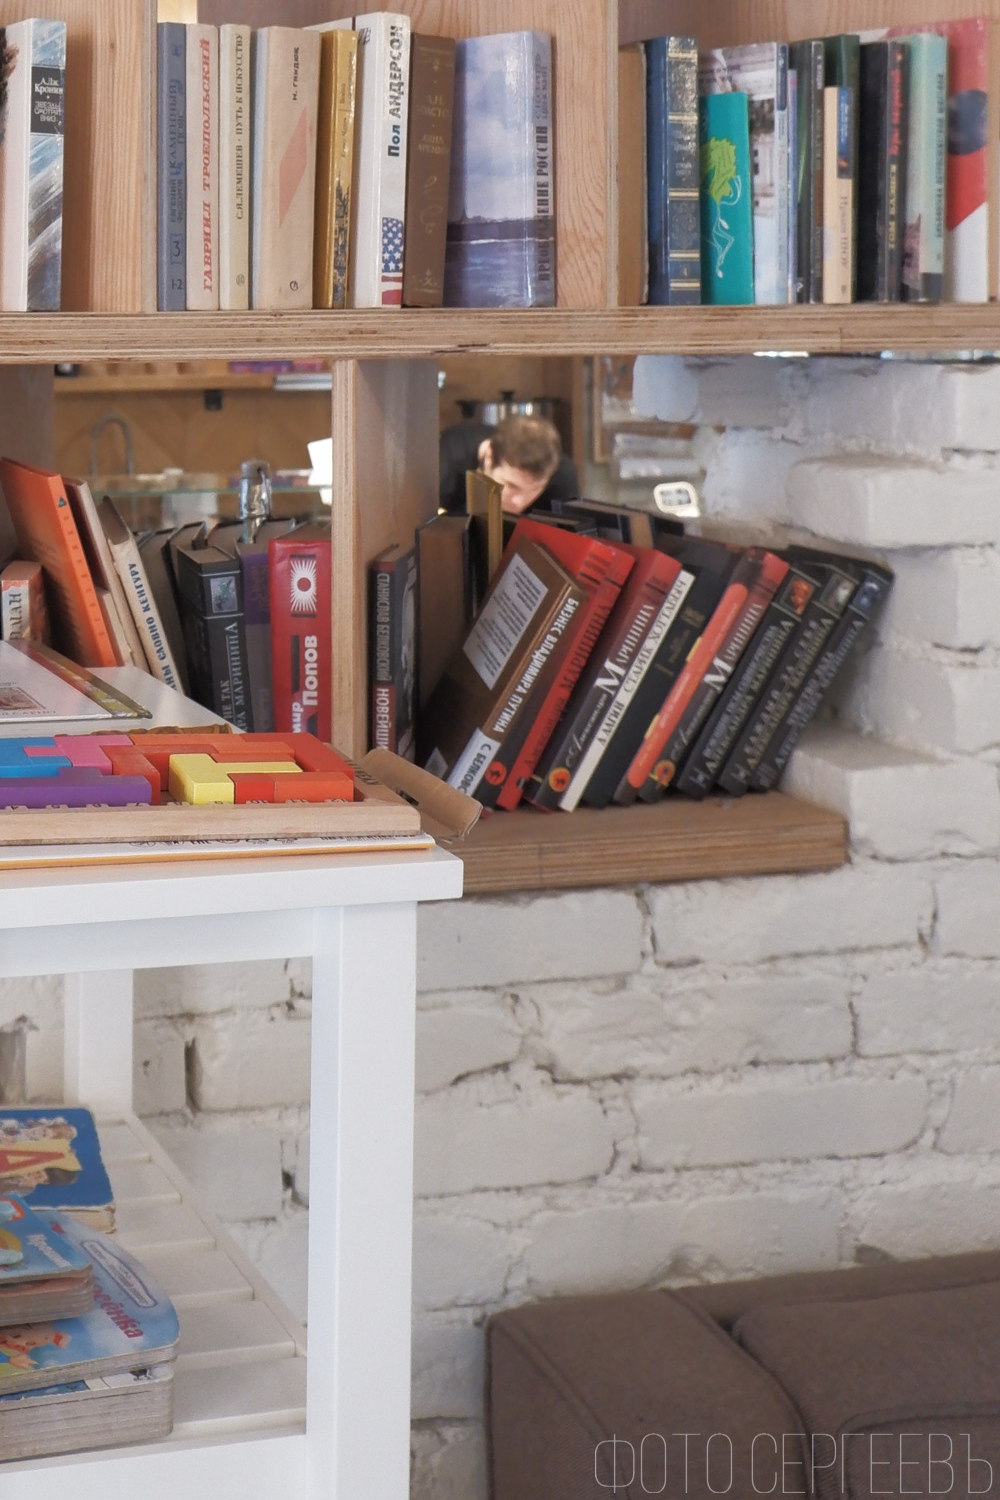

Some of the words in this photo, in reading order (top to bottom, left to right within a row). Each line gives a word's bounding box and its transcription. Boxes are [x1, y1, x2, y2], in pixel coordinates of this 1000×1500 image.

[34, 84, 63, 94] Кронин
[234, 32, 243, 93] ИСКУССТВУ
[387, 24, 404, 118] АНДЕРСОН
[199, 37, 211, 191] ТРОЕПОЛЬСКИЙ
[235, 95, 242, 103] К
[235, 106, 243, 134] ПУТЬ
[386, 123, 401, 157] Пол
[535, 125, 548, 176] РОССИИ
[172, 240, 180, 256] 3
[201, 199, 213, 292] ГАВРИИЛ
[535, 180, 549, 281] ПРЕОБРАЖЕНИЕ
[124, 561, 154, 613] КЕНГУРУ
[376, 572, 390, 623] СТАНИСЛАВ
[142, 615, 169, 661] СЛОВНО
[549, 595, 580, 636] БИЗНЕС
[620, 642, 654, 695] СТАРИК
[647, 576, 688, 645] ХОТТАБЫЧ
[224, 621, 245, 706] МАРИНИНА
[299, 634, 319, 706] Попов
[375, 624, 391, 680] БЕЛКОВСКИЙ
[513, 630, 558, 695] ВЛАДИМИРА
[558, 600, 613, 693] МАРИНИНА
[744, 616, 795, 693] МАРИНИНА
[219, 679, 229, 701] ТАК
[491, 691, 524, 735] ПУТИНА
